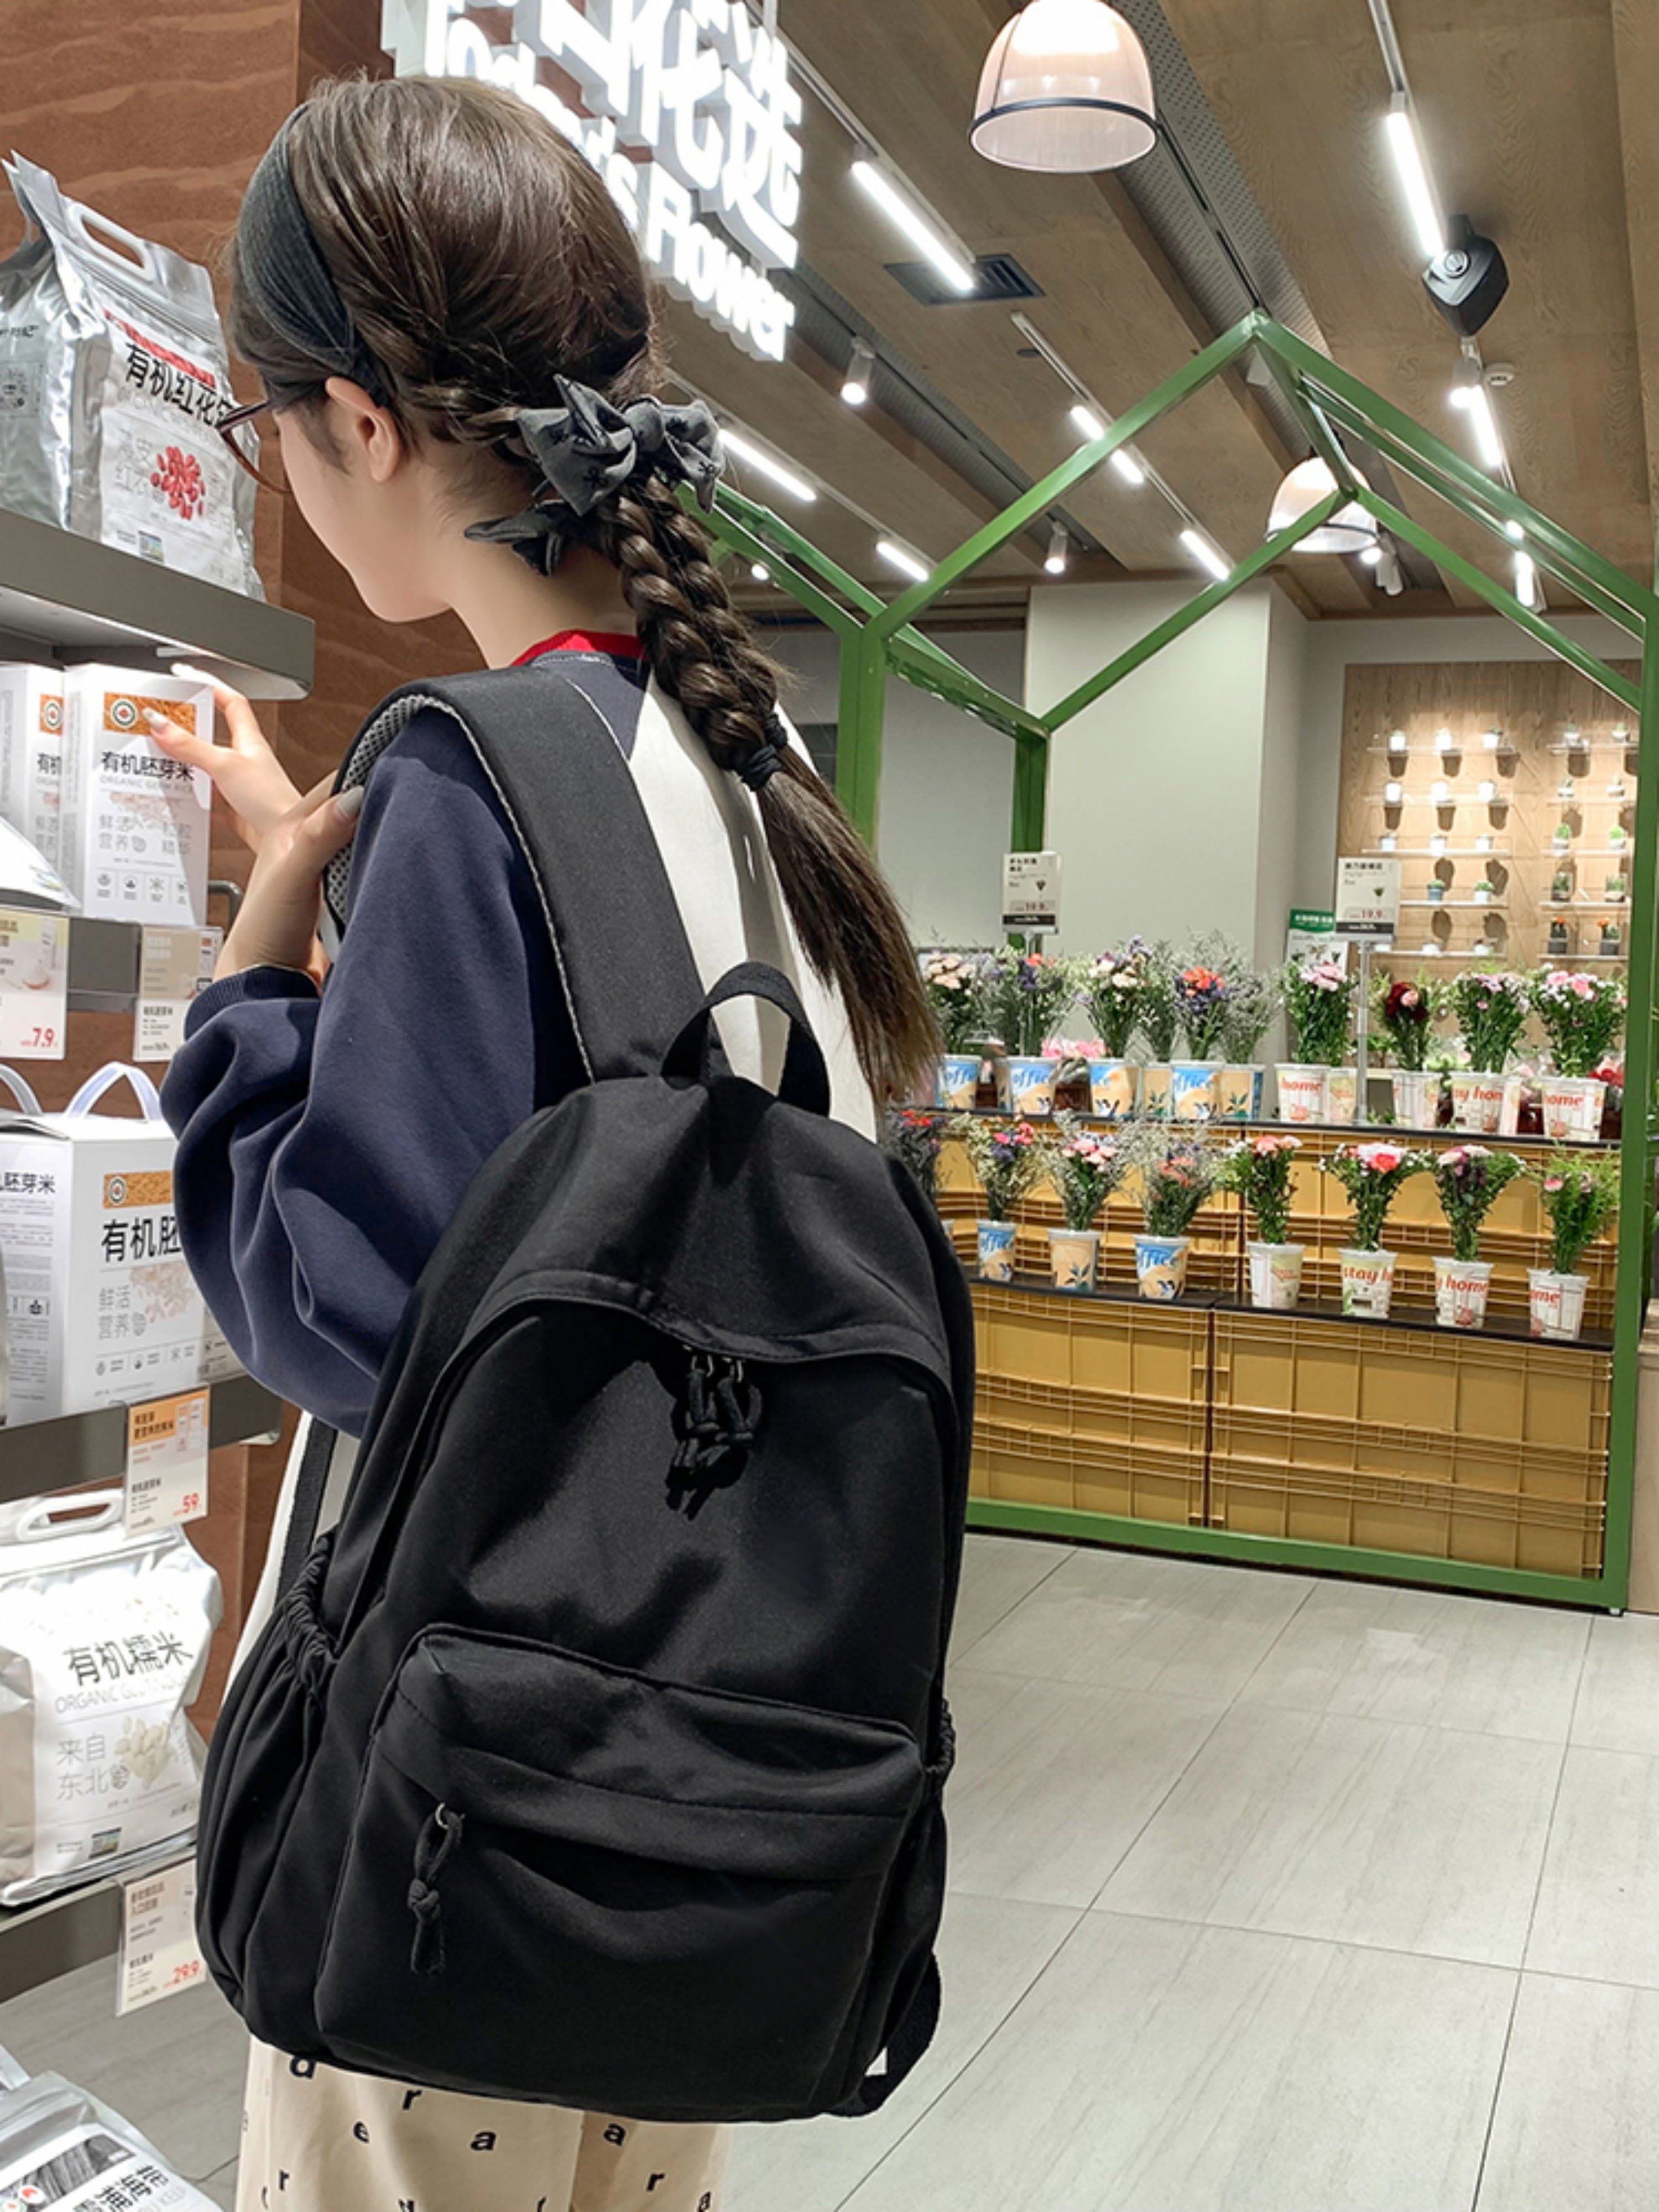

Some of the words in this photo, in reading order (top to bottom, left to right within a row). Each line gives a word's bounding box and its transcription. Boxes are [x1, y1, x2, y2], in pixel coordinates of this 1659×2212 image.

[101, 751, 195, 781] 有机胚芽米
[62, 1631, 193, 1686] 有机糯米
[58, 1734, 106, 1766] 来自
[58, 1768, 108, 1801] 东北
[470, 2131, 497, 2151] a
[603, 2124, 627, 2146] a
[646, 2173, 665, 2191] r
